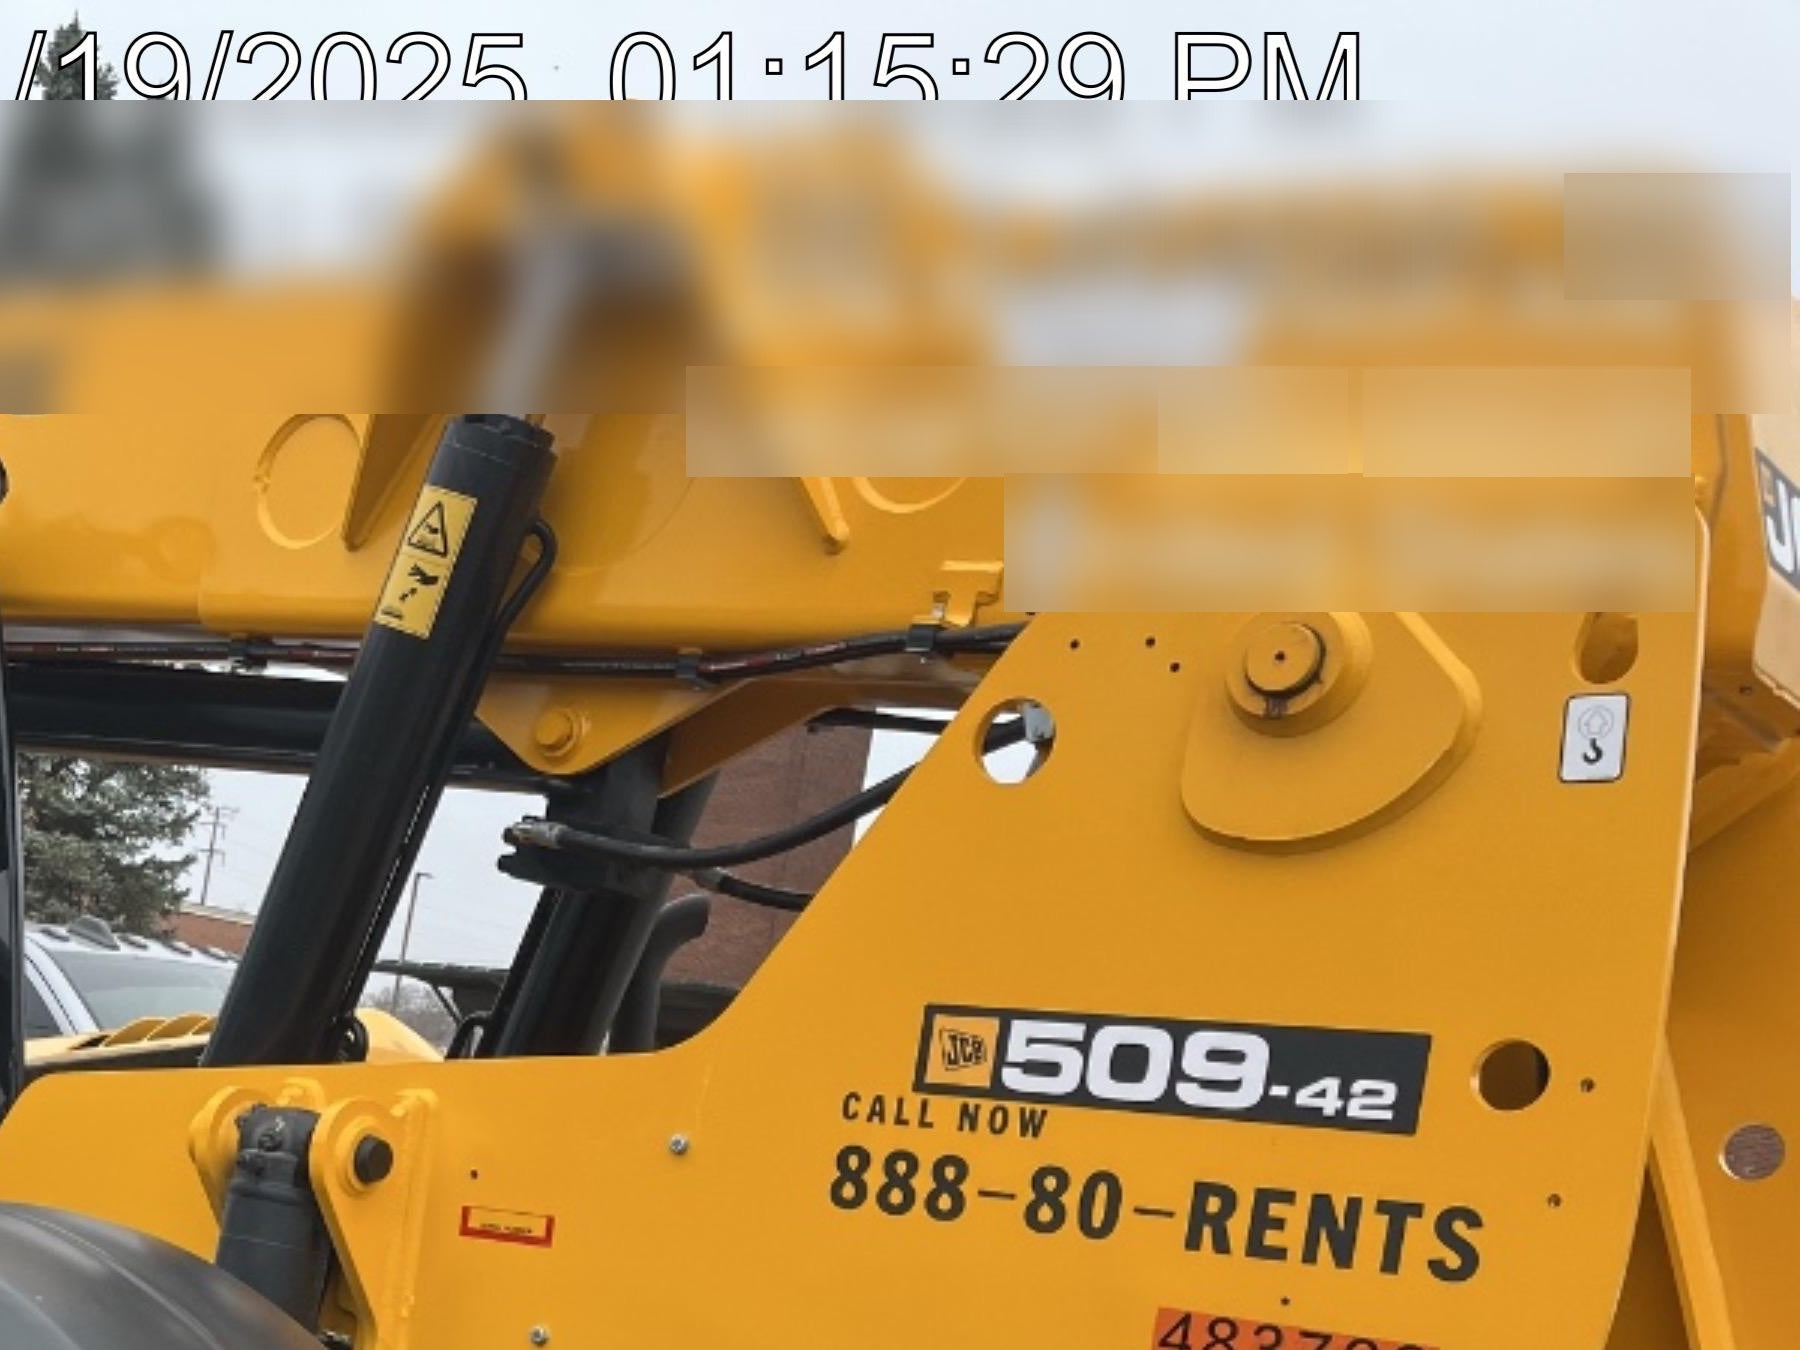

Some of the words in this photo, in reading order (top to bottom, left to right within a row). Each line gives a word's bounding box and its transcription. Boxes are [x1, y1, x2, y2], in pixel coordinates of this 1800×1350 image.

[842, 1093, 934, 1129] CALL
[957, 1103, 1048, 1138] NOW
[1001, 1019, 1397, 1121] 509-42
[830, 1144, 1485, 1283] 888-80-RENTS
